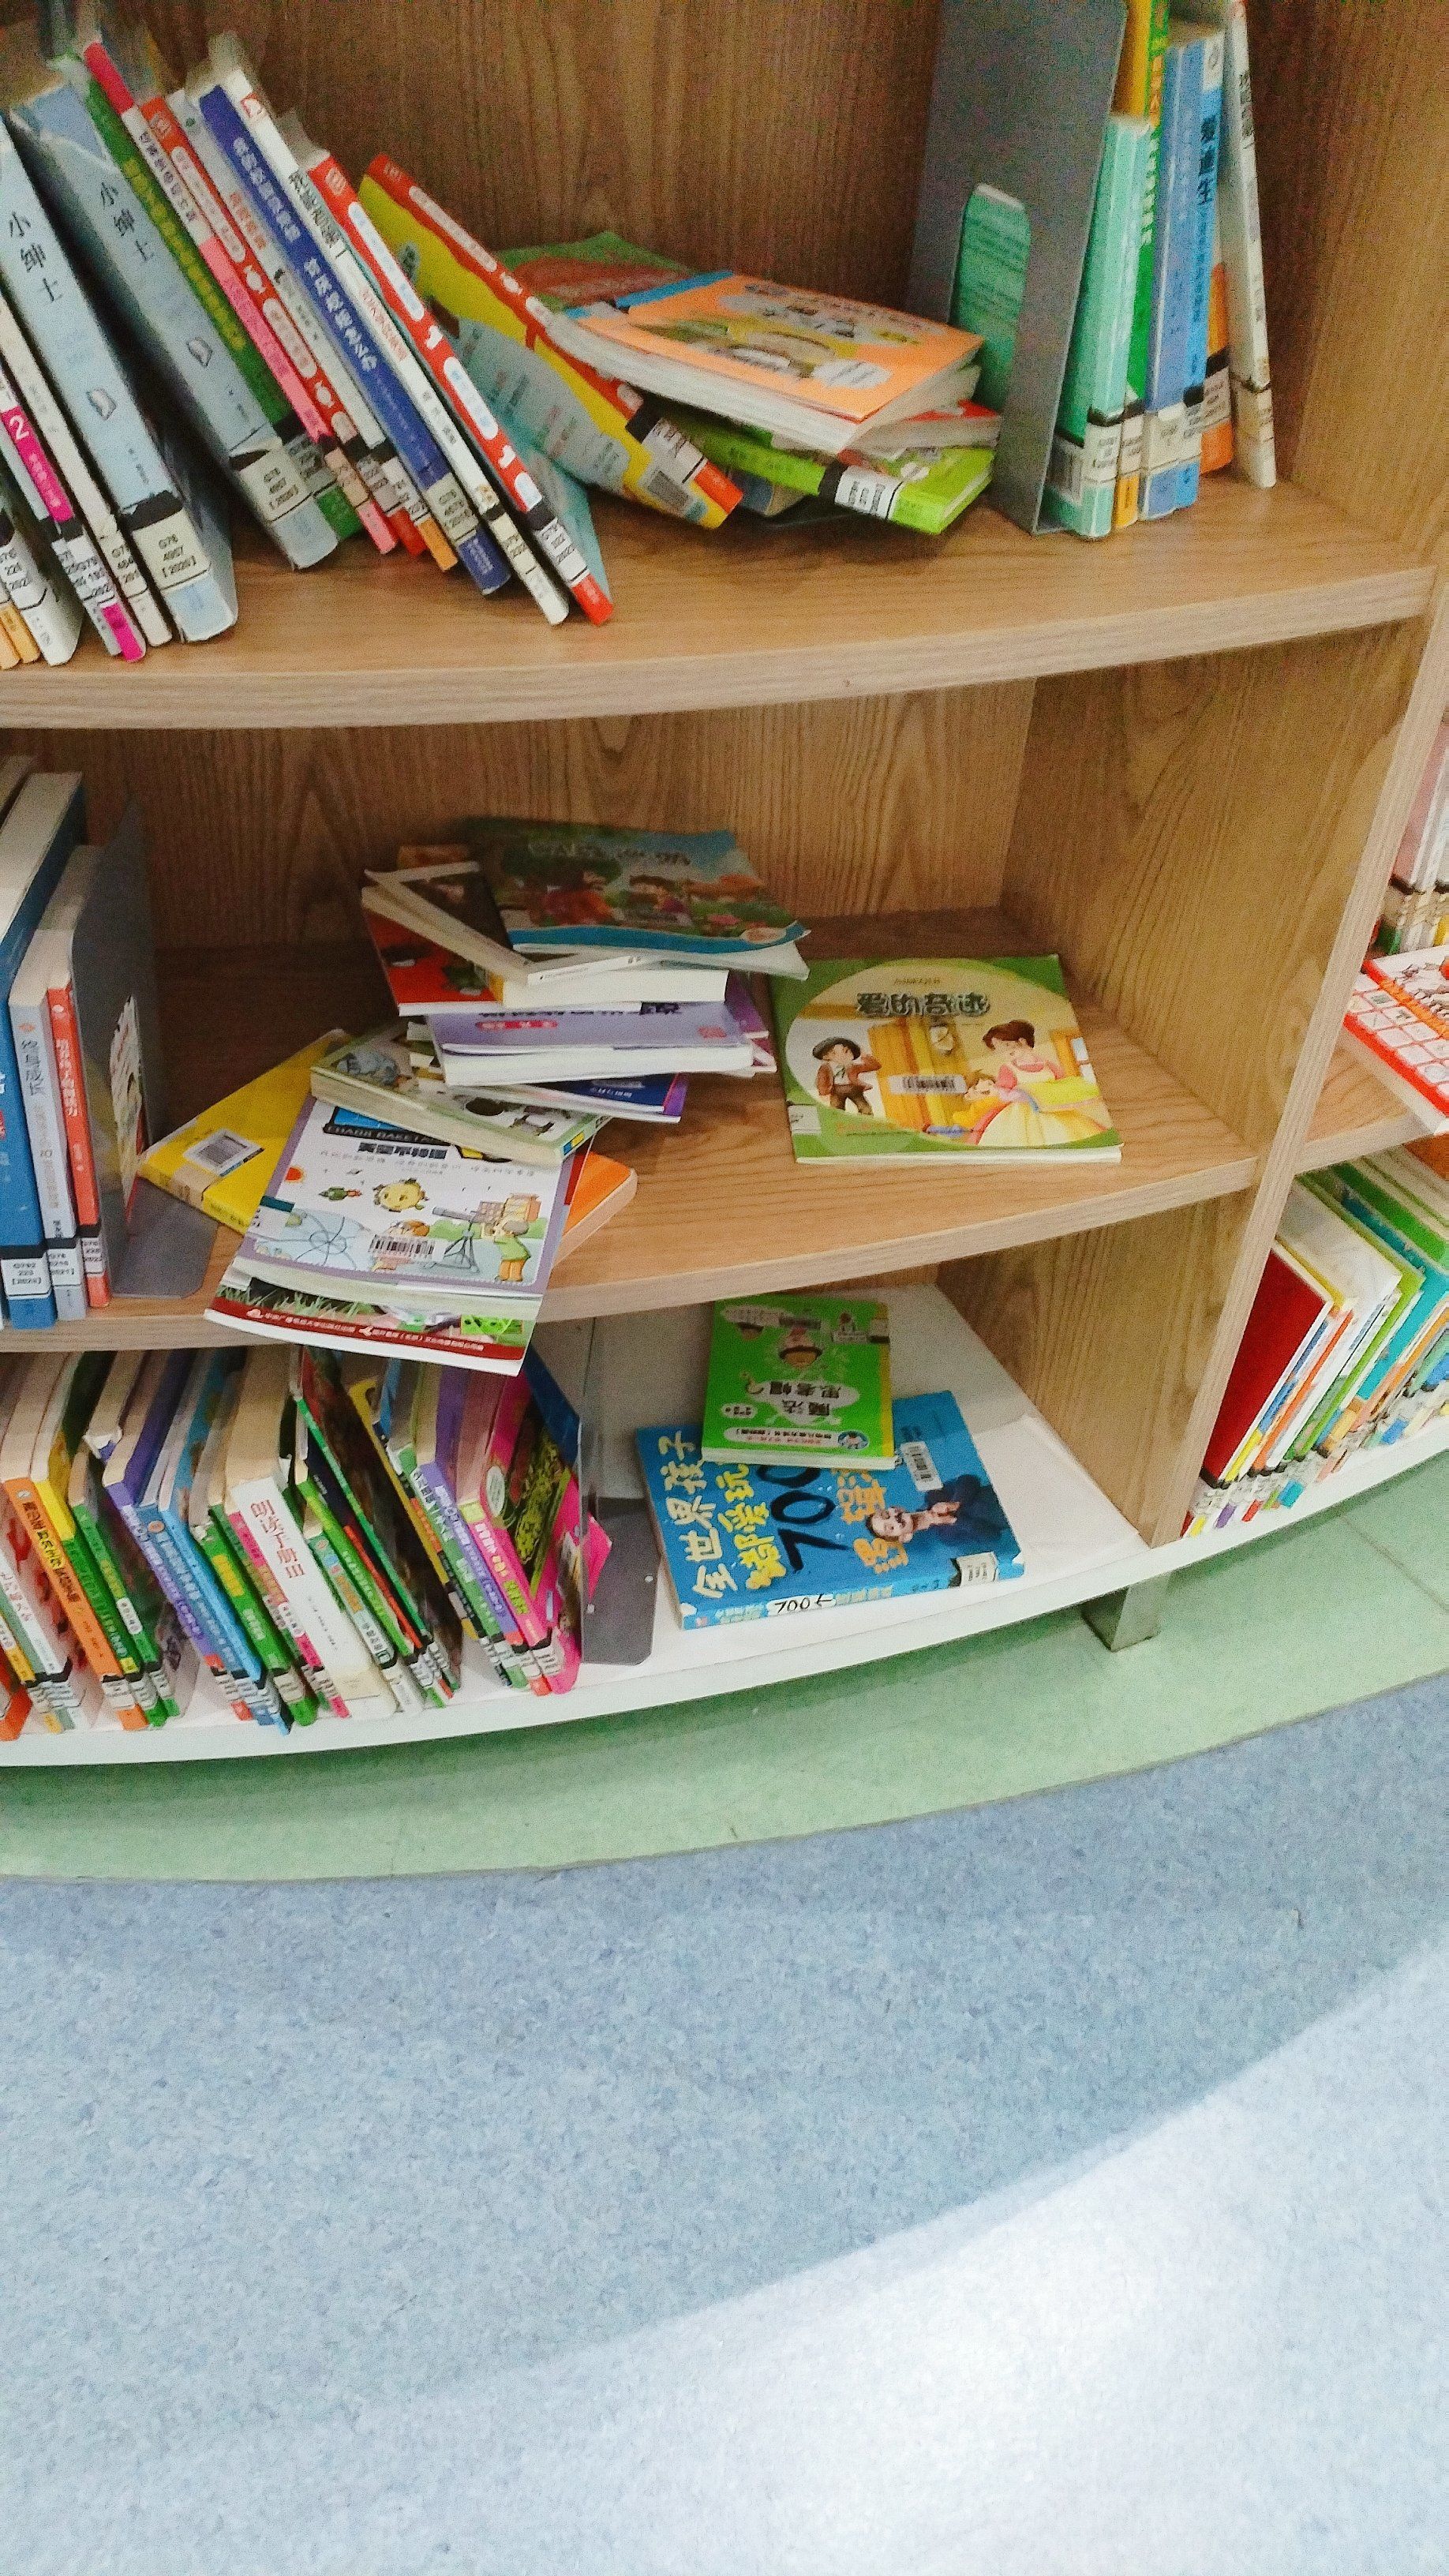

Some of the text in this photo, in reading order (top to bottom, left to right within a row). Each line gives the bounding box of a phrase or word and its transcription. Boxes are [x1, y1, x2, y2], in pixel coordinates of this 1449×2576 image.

[9, 211, 62, 305] 小绅士
[100, 182, 155, 264] 小绅士
[10, 415, 30, 440] 2
[781, 1400, 831, 1417] 魔法
[658, 1430, 739, 1599] 全世界孩子
[716, 1462, 787, 1590] 都爱玩
[774, 1594, 833, 1613] 700个
